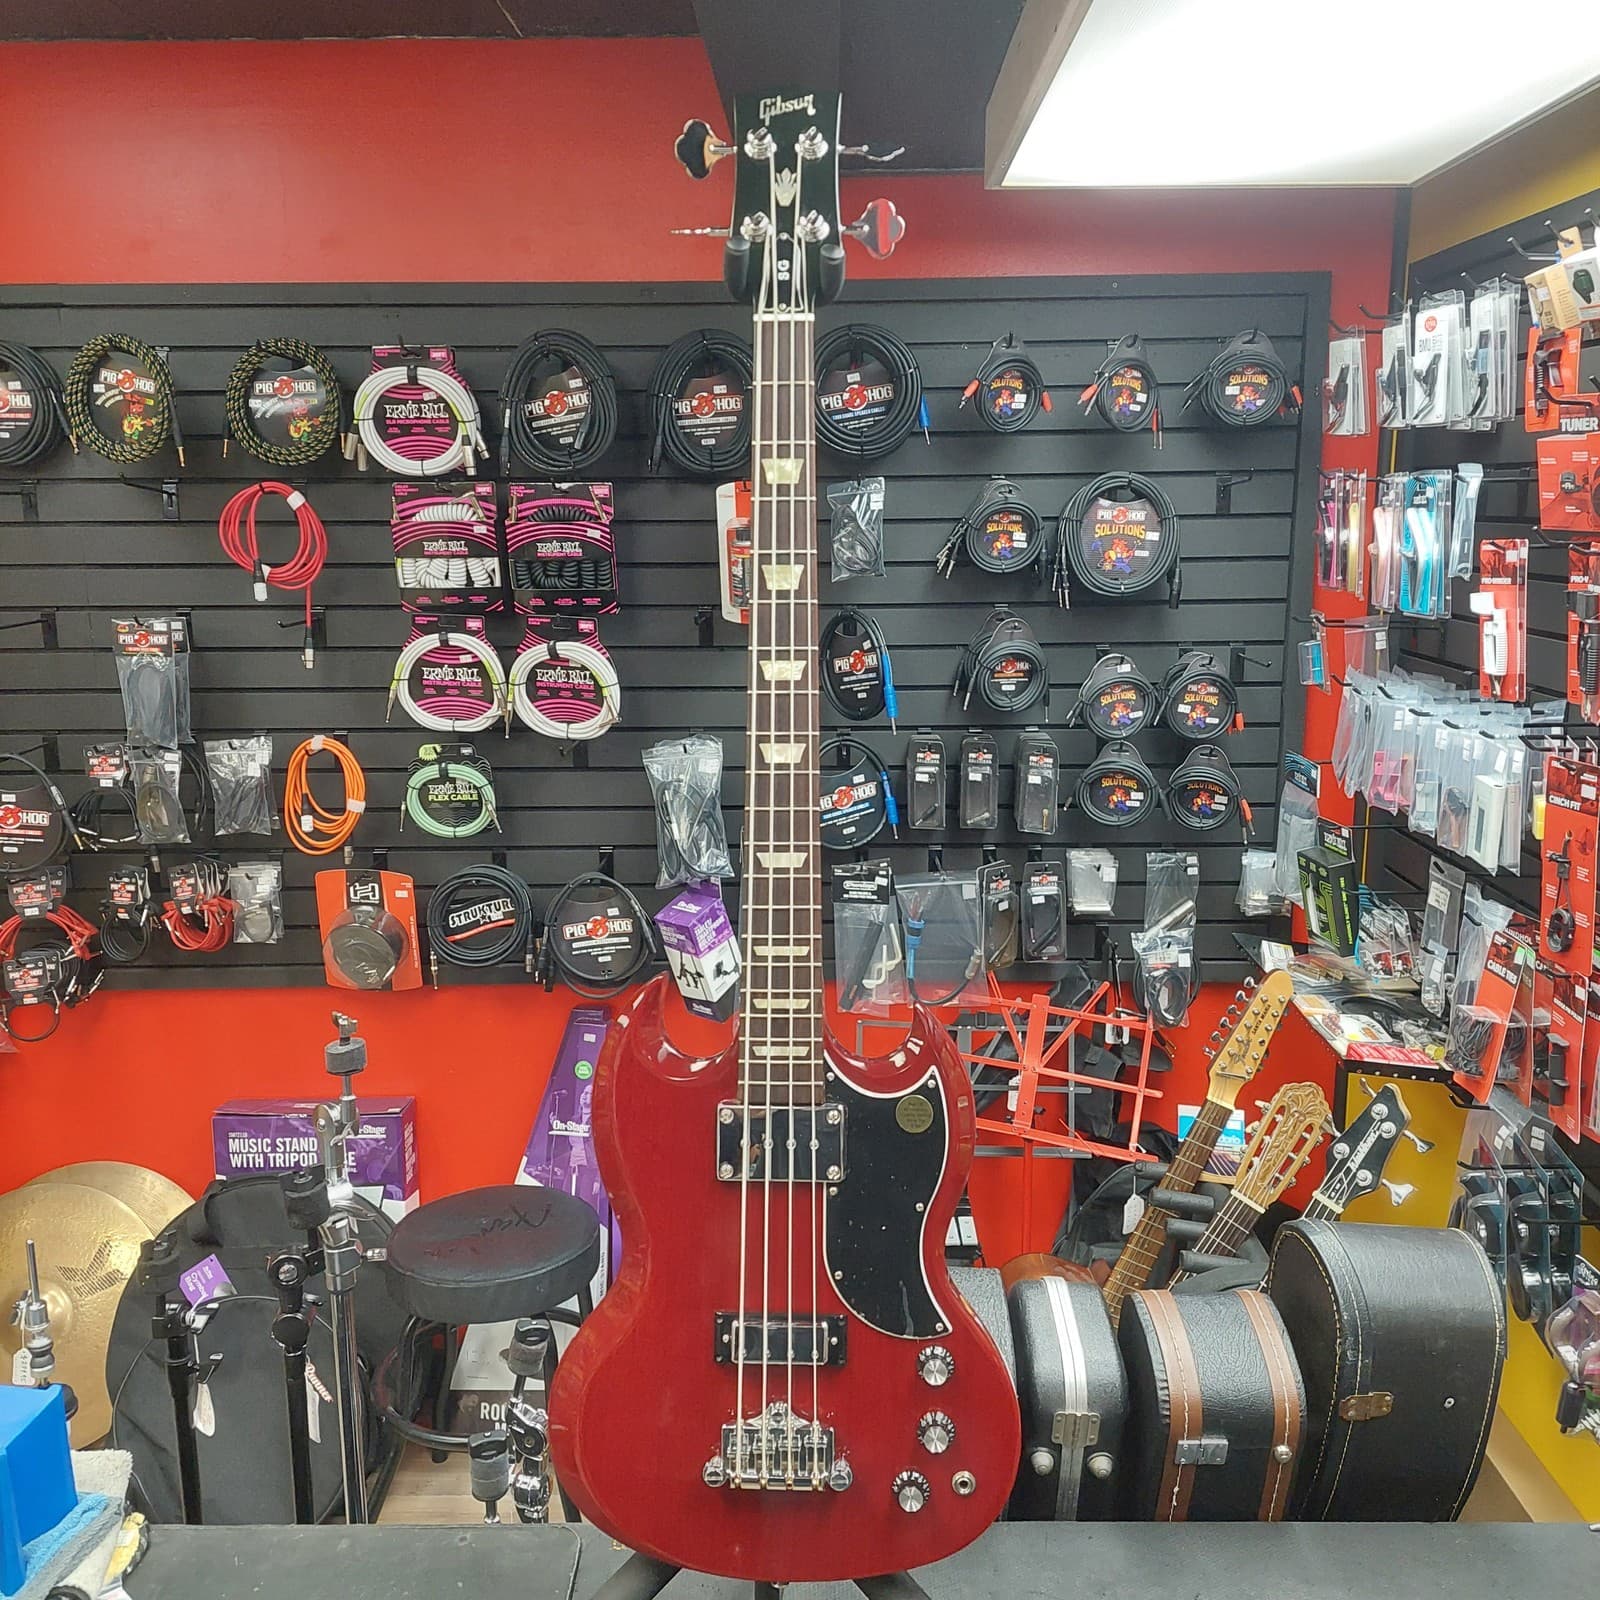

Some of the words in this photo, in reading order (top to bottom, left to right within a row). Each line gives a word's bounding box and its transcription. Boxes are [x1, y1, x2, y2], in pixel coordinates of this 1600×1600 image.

[759, 94, 817, 126] Gibson
[777, 259, 790, 281] SG
[101, 370, 117, 384] PIG
[135, 378, 155, 392] HOG
[990, 377, 1023, 390] SOLUTIONS
[1111, 376, 1142, 390] SOLUTIONS
[1229, 374, 1268, 386] SOLUTIONS
[255, 383, 273, 393] PIG
[294, 382, 316, 392] HOG
[715, 397, 741, 410] HOG
[820, 394, 842, 410] PIG
[868, 385, 892, 401] HOG
[384, 400, 420, 418] ERNIE
[420, 402, 449, 419] BALL
[524, 402, 544, 416] PIG
[1560, 417, 1599, 431] TUNER
[986, 522, 1023, 534] SOLUTIONS
[1094, 524, 1146, 540] SOLUTIONS
[421, 664, 454, 680] ERNIE
[454, 667, 482, 681] BALL
[835, 660, 850, 672] PIG
[535, 666, 568, 682] ERNIE
[568, 670, 594, 685] BALL
[1100, 690, 1136, 706] SOLUTIONS
[1184, 694, 1219, 706] SOLUTIONS
[1101, 777, 1138, 789] SOLUTIONS
[450, 793, 478, 801] CABLE
[819, 795, 832, 810] IG
[854, 784, 874, 800] HOG
[22, 812, 48, 825] HOG
[565, 924, 586, 938] PIG
[609, 919, 632, 933] HOG
[552, 1121, 590, 1133] On-Stage
[229, 1138, 271, 1153] MUSIC
[276, 1137, 318, 1153] STAND
[230, 1154, 264, 1168] WITH
[268, 1152, 318, 1167] TRIPOD
